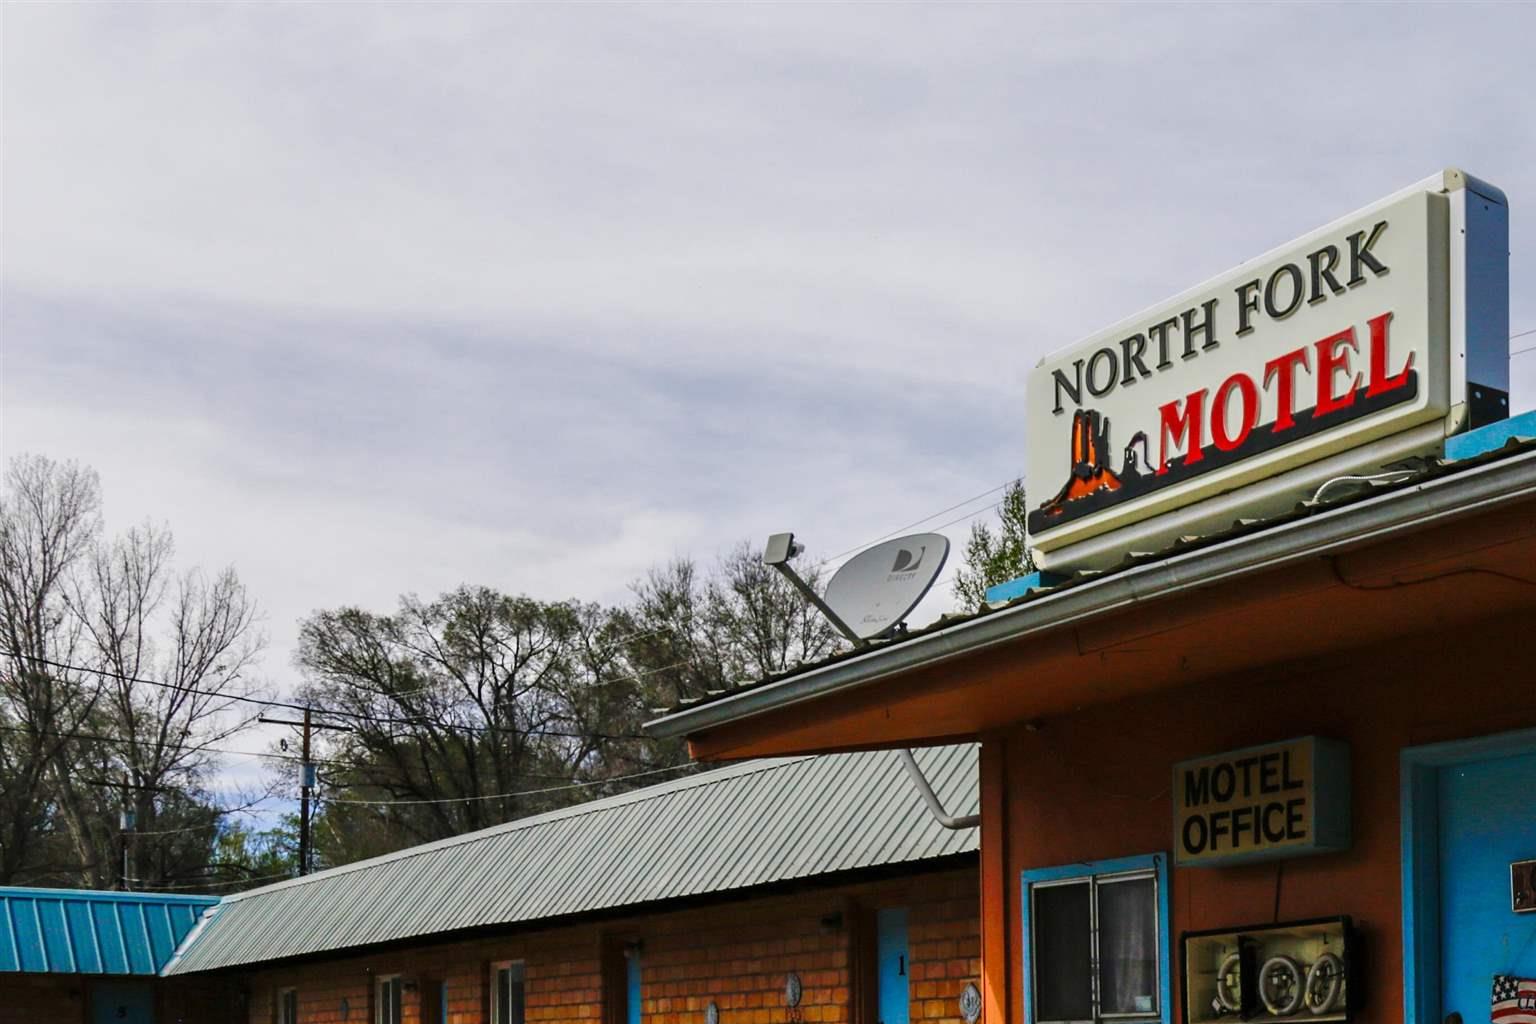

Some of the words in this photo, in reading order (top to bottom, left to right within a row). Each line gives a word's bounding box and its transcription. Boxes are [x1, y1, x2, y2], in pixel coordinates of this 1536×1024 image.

[1051, 298, 1219, 415] NORTH
[1235, 220, 1390, 336] FORK
[1155, 311, 1415, 476] MOTEL
[1182, 797, 1305, 855] OFFICE
[1184, 750, 1304, 807] MOTEL
